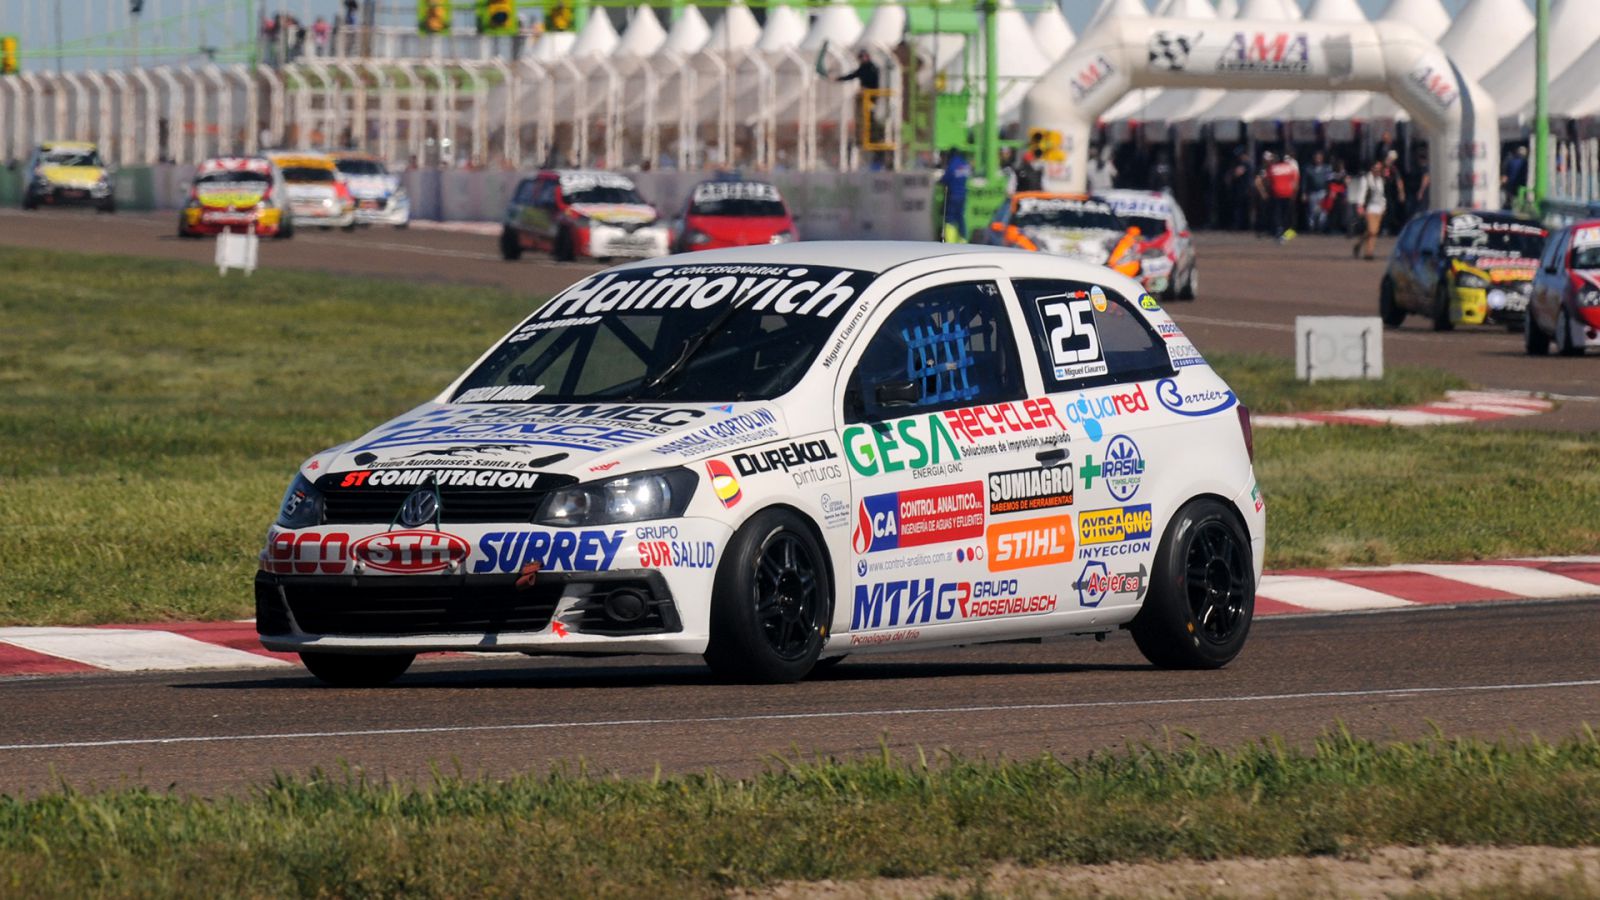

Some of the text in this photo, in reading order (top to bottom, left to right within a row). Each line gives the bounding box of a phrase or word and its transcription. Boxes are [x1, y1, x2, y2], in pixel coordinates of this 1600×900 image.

[1217, 31, 1309, 63] AMA
[674, 266, 788, 276] CONCESIONARIAS
[539, 268, 855, 319] Haimovich
[823, 338, 843, 369] Miguel
[841, 310, 863, 341] Ciaurro
[1044, 300, 1099, 364] 25
[1064, 364, 1106, 378] Miguel Ciaurro
[1156, 378, 1226, 409] Barrier
[468, 404, 706, 426] SIAMEC
[563, 418, 672, 434] ELECTRICAS
[709, 407, 777, 438] BORTOLINI
[944, 397, 1067, 444] RECYCLER
[842, 413, 961, 477] GESA
[960, 442, 998, 457] Soluciones
[998, 441, 1008, 452] de
[367, 458, 528, 470] Grupo Autobuses Santa Fe
[732, 440, 838, 477] DUREKOL
[948, 462, 964, 474] GNC
[792, 464, 842, 489] pinturas
[989, 466, 1073, 502] SUMIAGRO
[900, 500, 936, 519] CONTROL
[937, 493, 975, 513] ANALITICO
[990, 495, 1073, 512] SABEMOS DE HERRAMIENTAS
[635, 526, 679, 540] GRUPO
[873, 510, 897, 538] CA
[928, 522, 936, 532] DE
[936, 519, 953, 531] AGUAS
[956, 514, 983, 528] EFLUENTES
[366, 535, 451, 566] STH
[473, 530, 628, 573] SURREY
[995, 527, 1066, 562] STIHL
[1079, 542, 1151, 559] INYECCION
[973, 579, 1018, 598] GRUPO
[1087, 571, 1125, 593] Acier
[850, 578, 935, 631] MTH
[969, 594, 1057, 618] ROSENBUSCH
[892, 630, 904, 641] del
